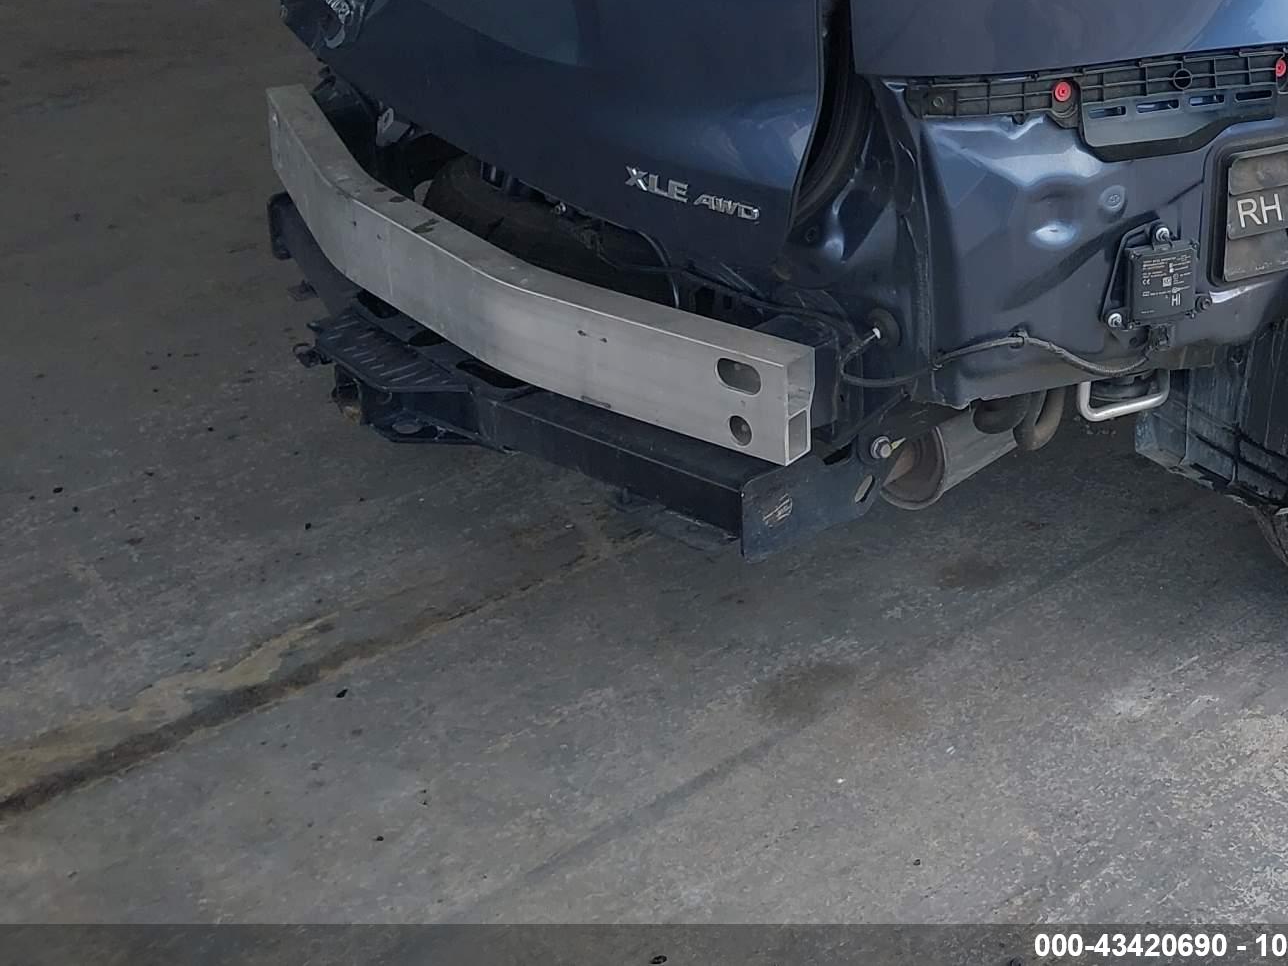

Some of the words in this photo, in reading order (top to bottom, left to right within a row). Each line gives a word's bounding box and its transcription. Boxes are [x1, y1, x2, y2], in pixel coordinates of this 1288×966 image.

[625, 166, 689, 203] XLE
[693, 194, 761, 221] AWD
[1236, 193, 1284, 229] RH
